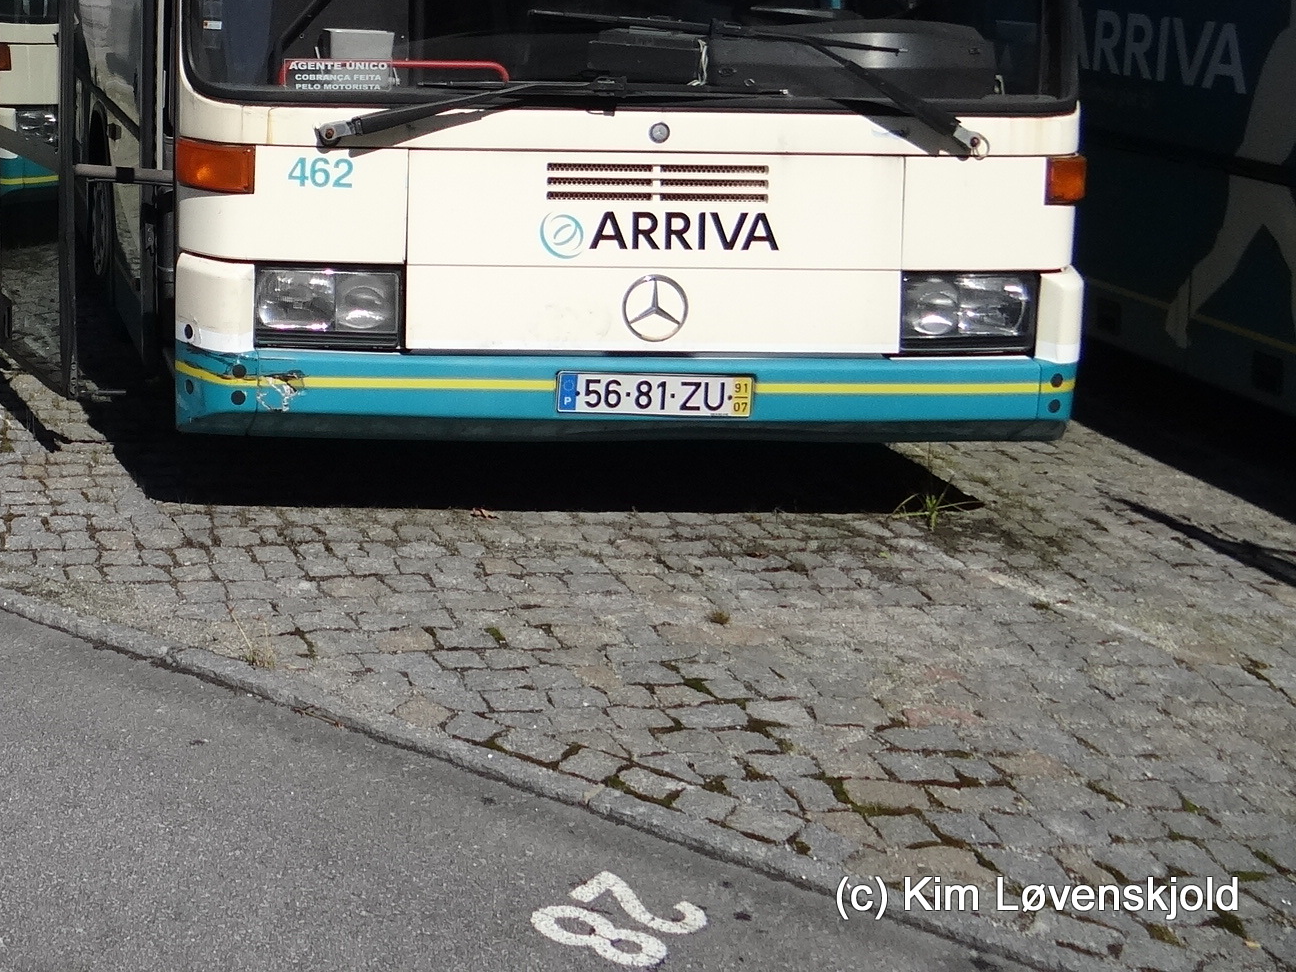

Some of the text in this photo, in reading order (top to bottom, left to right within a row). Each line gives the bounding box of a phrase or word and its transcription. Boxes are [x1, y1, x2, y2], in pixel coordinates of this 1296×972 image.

[289, 59, 388, 70] AGENTE ÚNICO
[295, 74, 351, 82] COBRANÇA
[288, 157, 353, 189] 462
[589, 211, 779, 251] ARRIVA
[734, 383, 749, 394] 91
[564, 396, 572, 406] P
[733, 401, 749, 413] 07
[530, 870, 708, 967] 28
